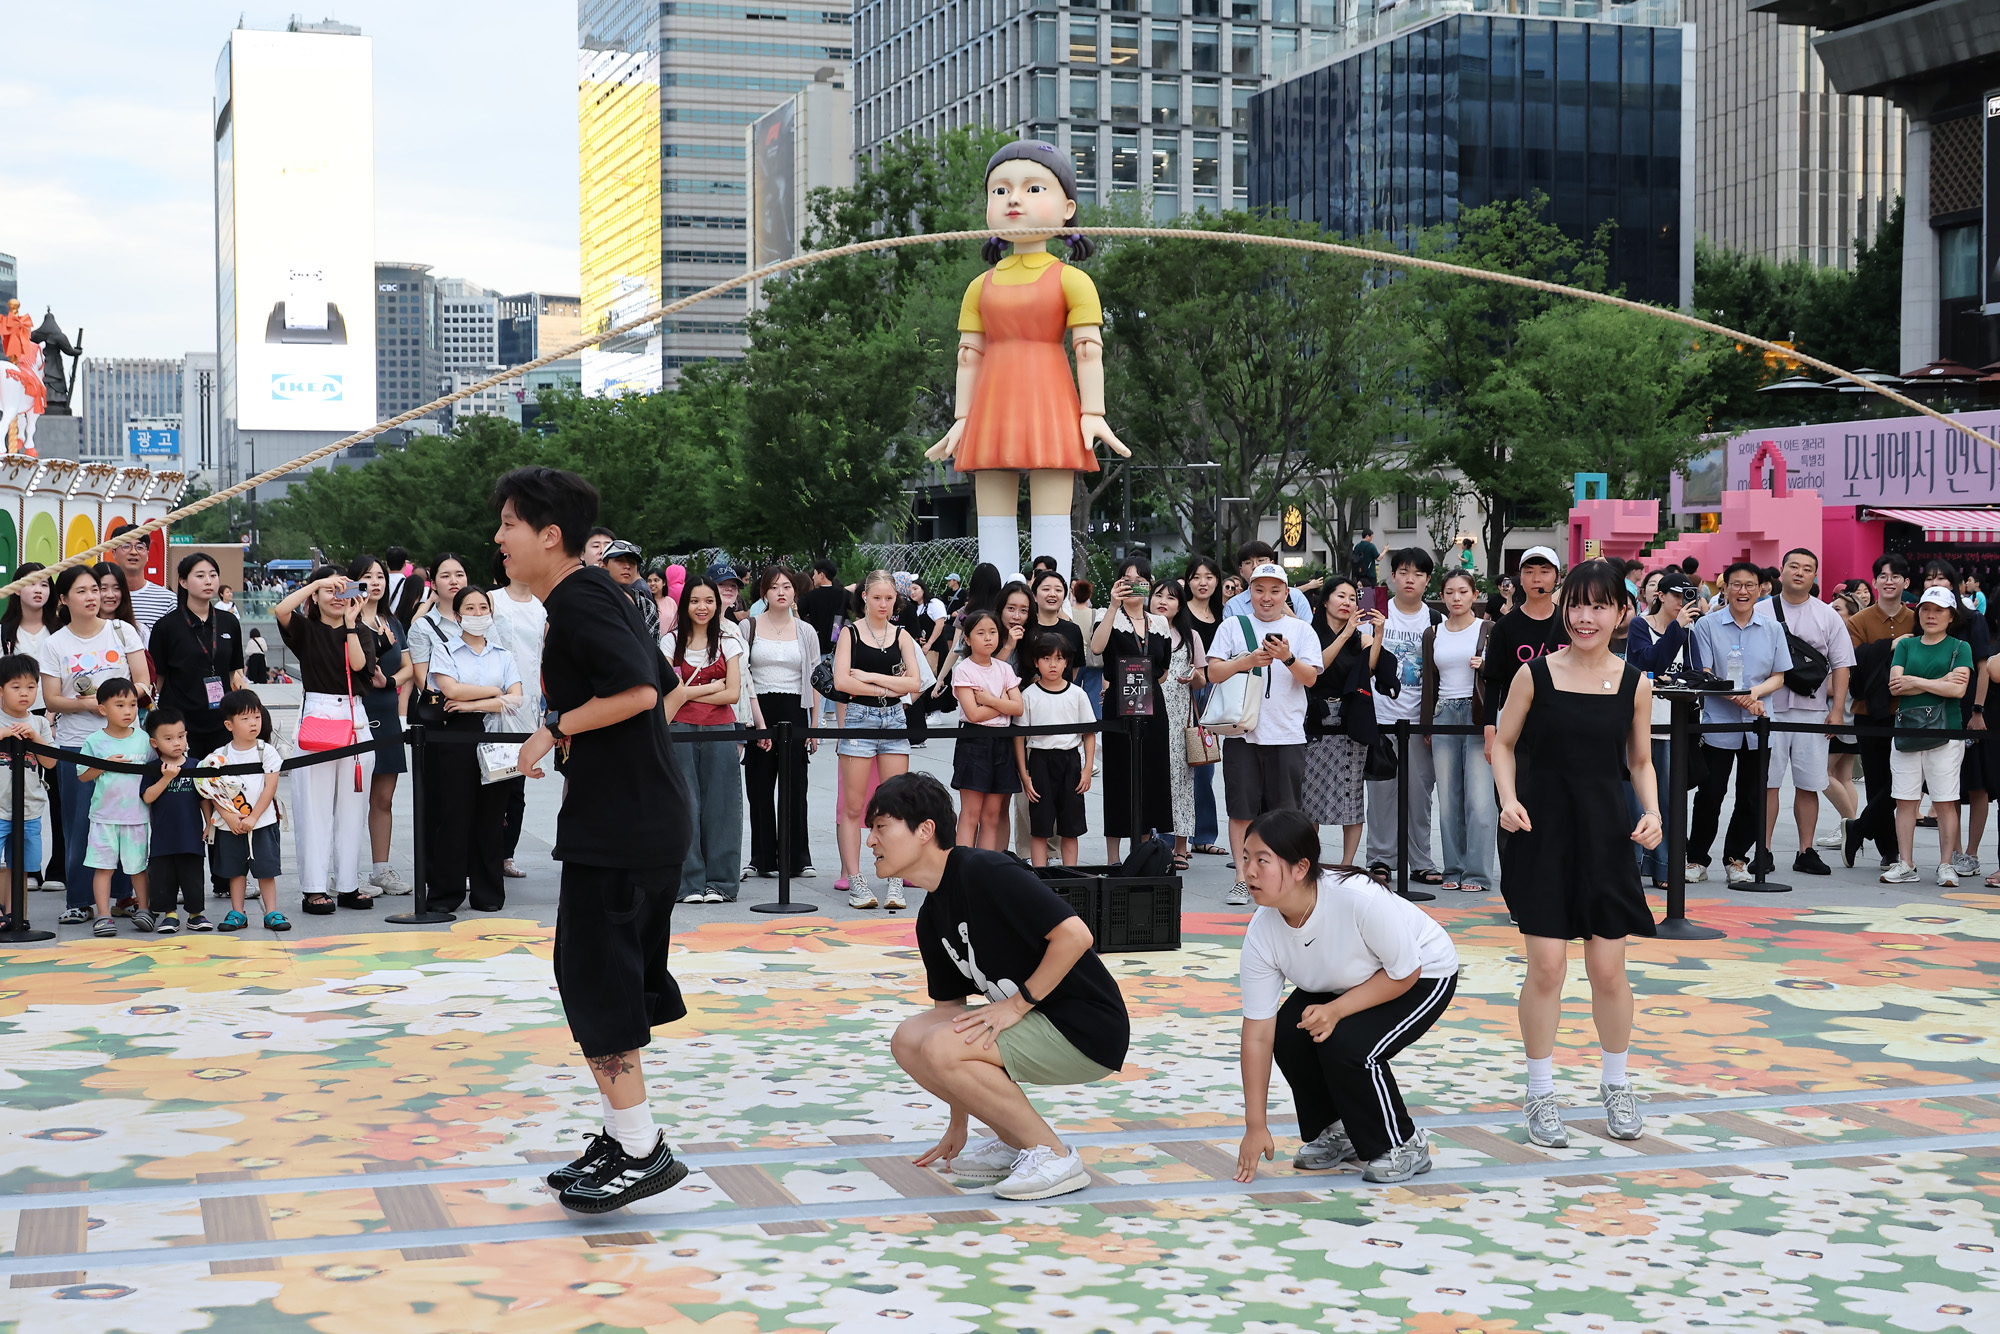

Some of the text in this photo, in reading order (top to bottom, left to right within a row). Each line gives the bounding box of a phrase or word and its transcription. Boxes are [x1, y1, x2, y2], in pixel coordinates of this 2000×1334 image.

[379, 284, 397, 292] ICBC
[279, 382, 336, 392] IKEA
[136, 431, 172, 448] 광고
[1738, 437, 1825, 455] 요하네그 아트 갤러리
[1801, 454, 1825, 467] 특별전
[1842, 425, 2000, 498] 모네에서 앤디
[1787, 471, 1825, 489] warhol
[1384, 628, 1396, 640] HE
[1126, 673, 1145, 685] 출구
[1123, 685, 1148, 696] EXIT
